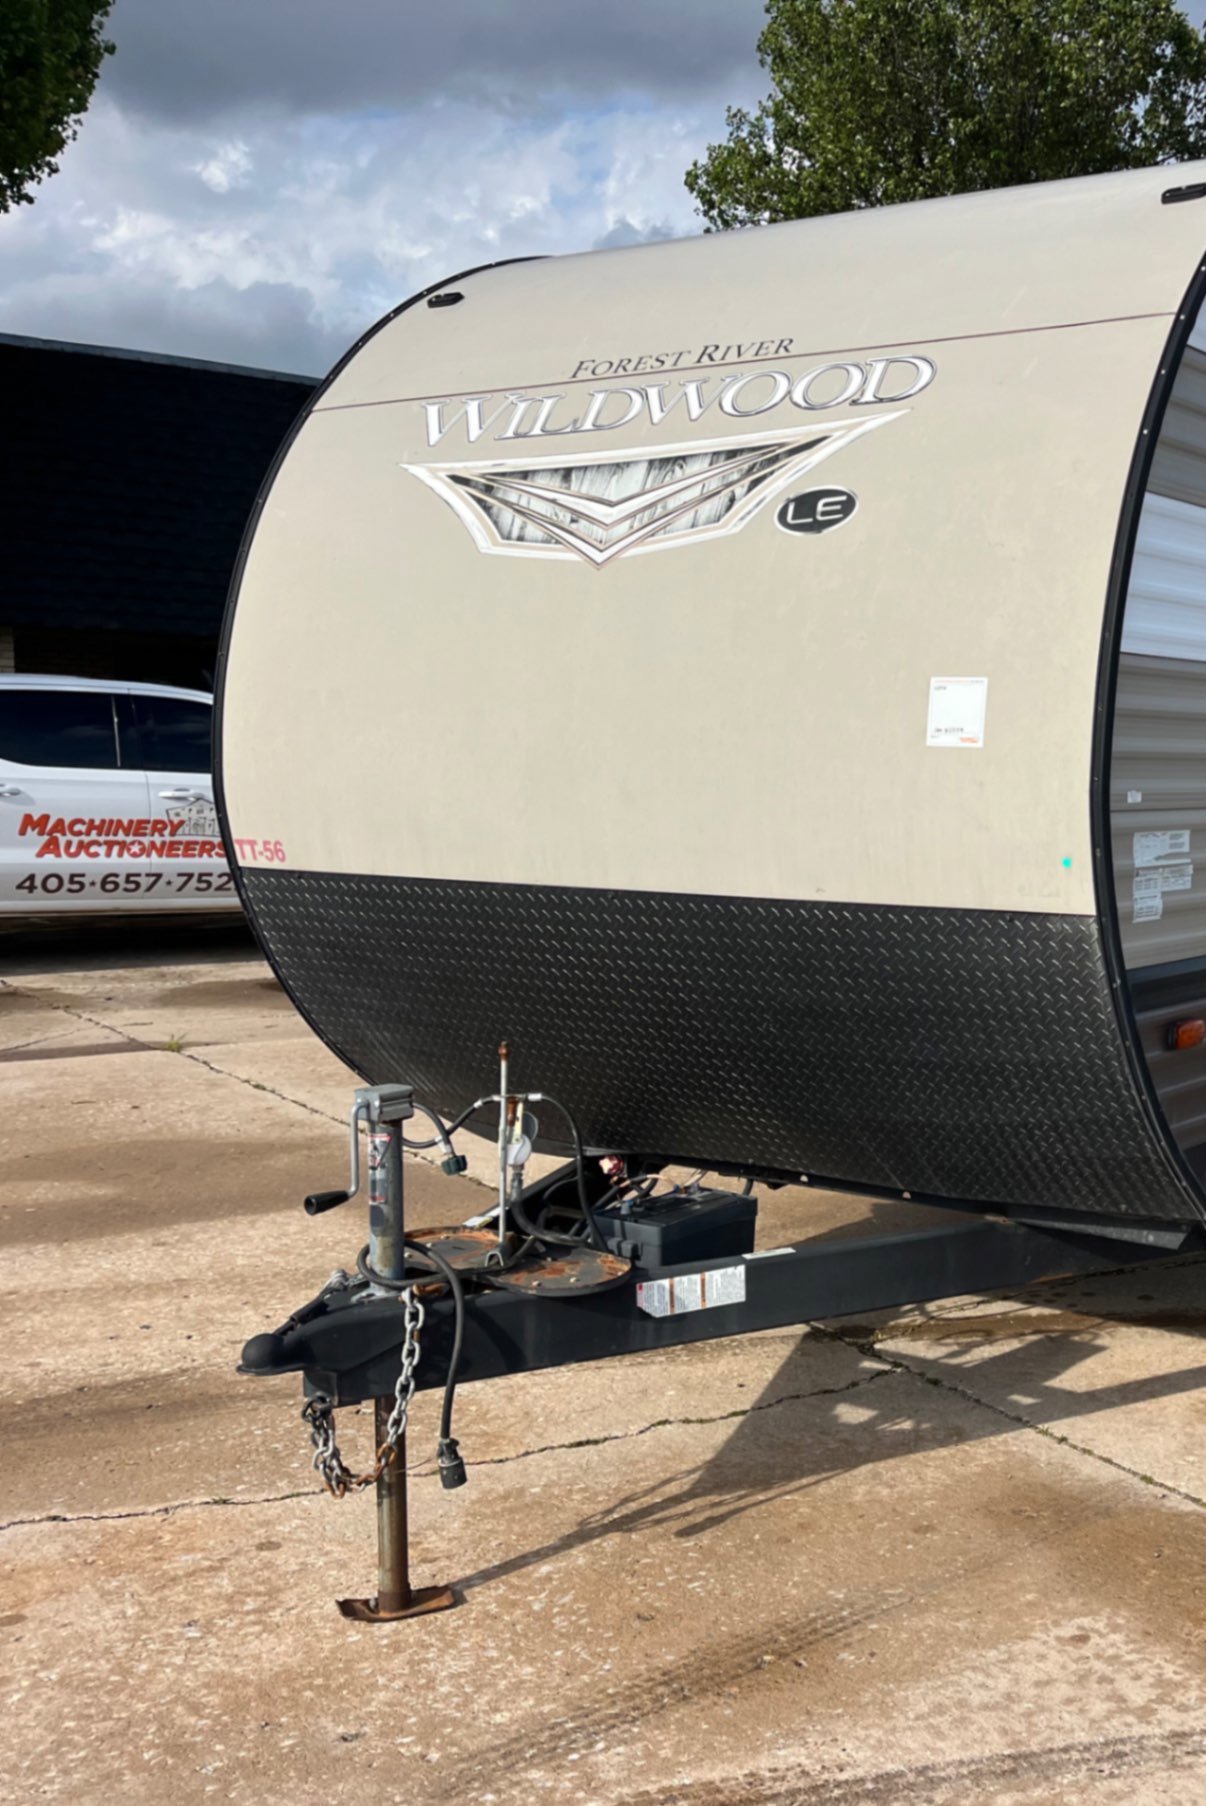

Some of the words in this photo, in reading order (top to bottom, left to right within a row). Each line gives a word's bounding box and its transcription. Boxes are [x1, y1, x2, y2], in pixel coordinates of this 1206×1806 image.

[571, 350, 692, 379] FOREST
[695, 338, 794, 364] RIVER
[422, 355, 937, 446] WILDWOOD
[786, 495, 848, 523] LE
[18, 813, 185, 837] MACHINERY
[234, 838, 286, 862] TT-56
